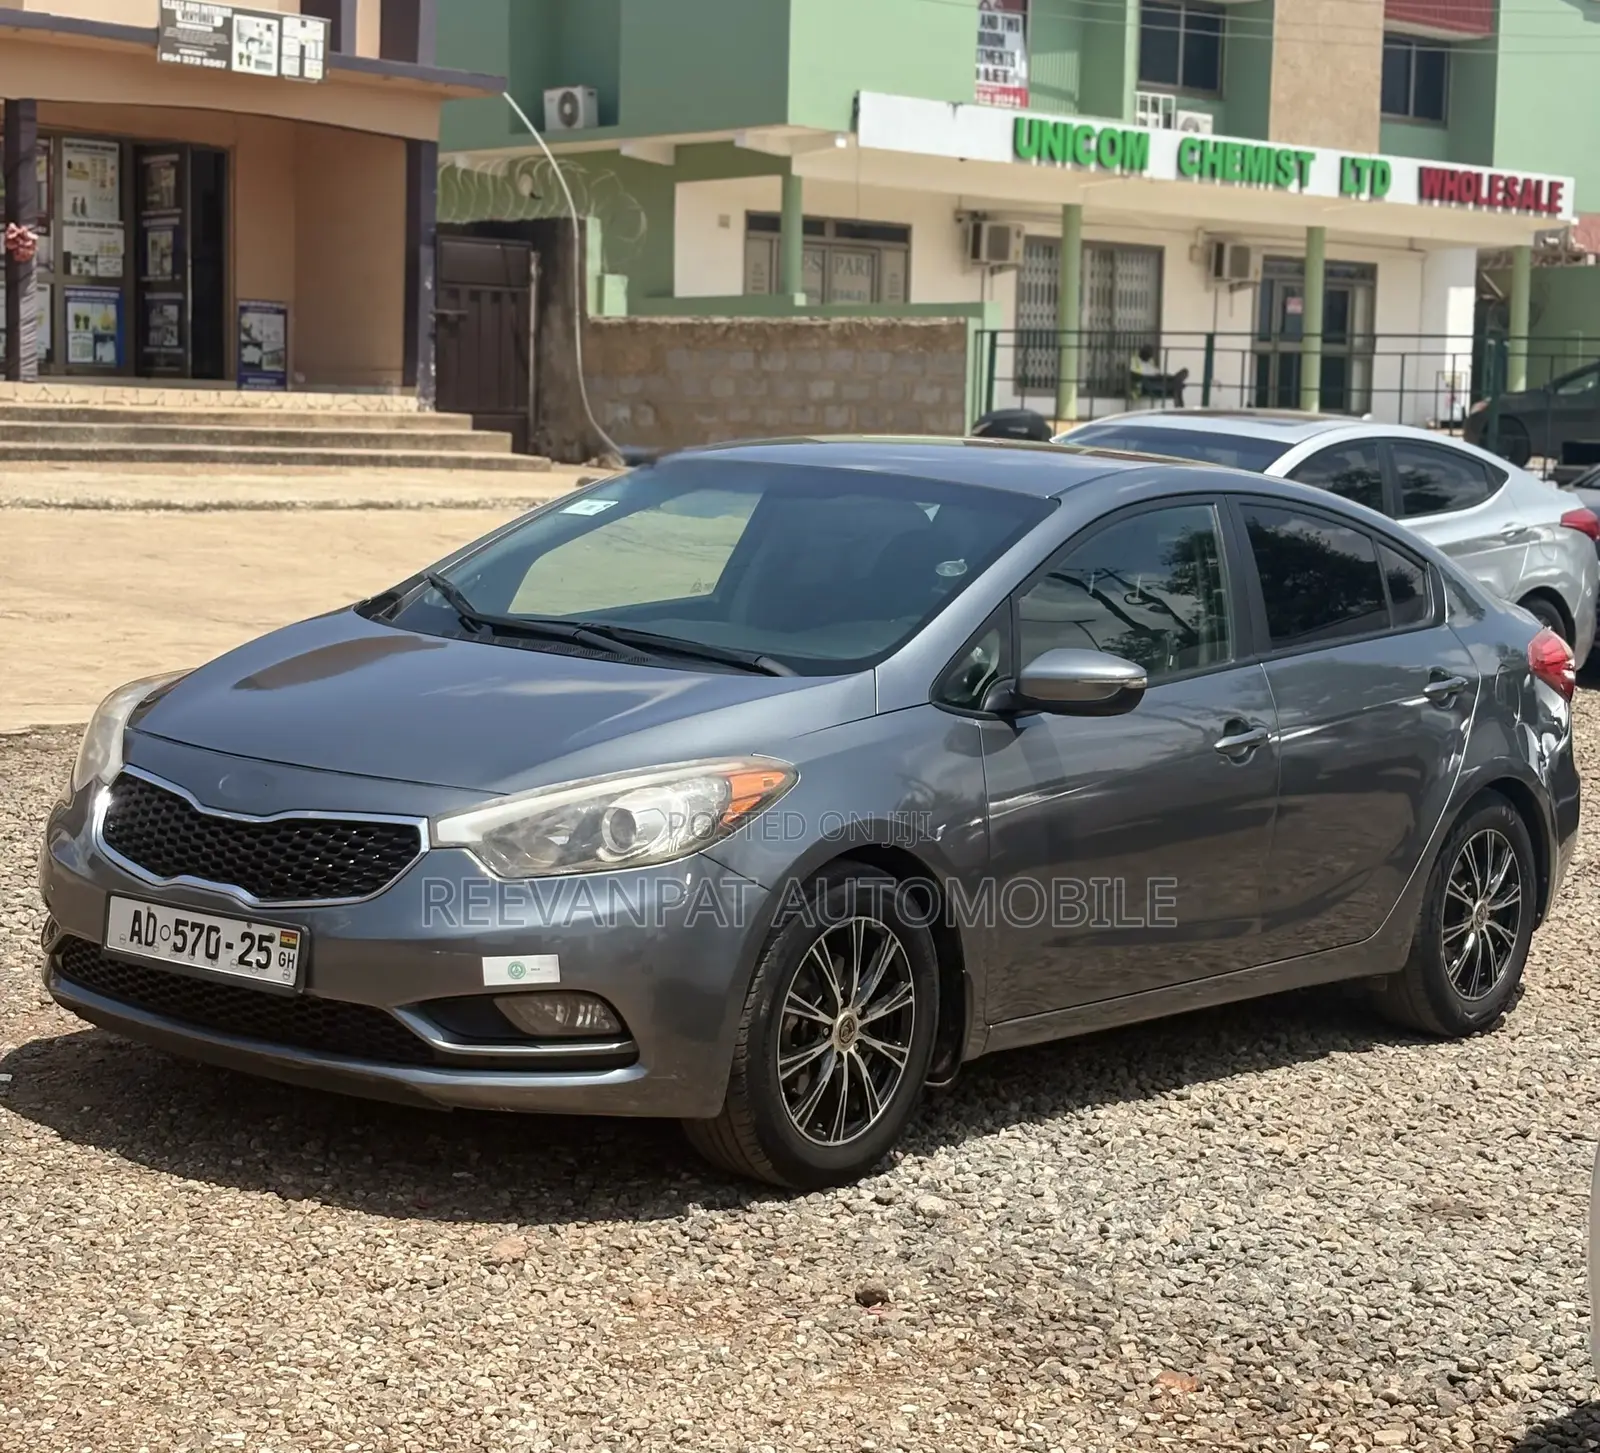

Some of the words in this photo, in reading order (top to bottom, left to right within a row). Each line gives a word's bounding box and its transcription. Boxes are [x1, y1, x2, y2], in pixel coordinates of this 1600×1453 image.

[1014, 116, 1151, 172] UNICOM
[1177, 136, 1316, 189] CHEMIST
[1340, 156, 1392, 197] LTD
[1419, 166, 1564, 214] WHOLESALE
[278, 951, 295, 969] GH
